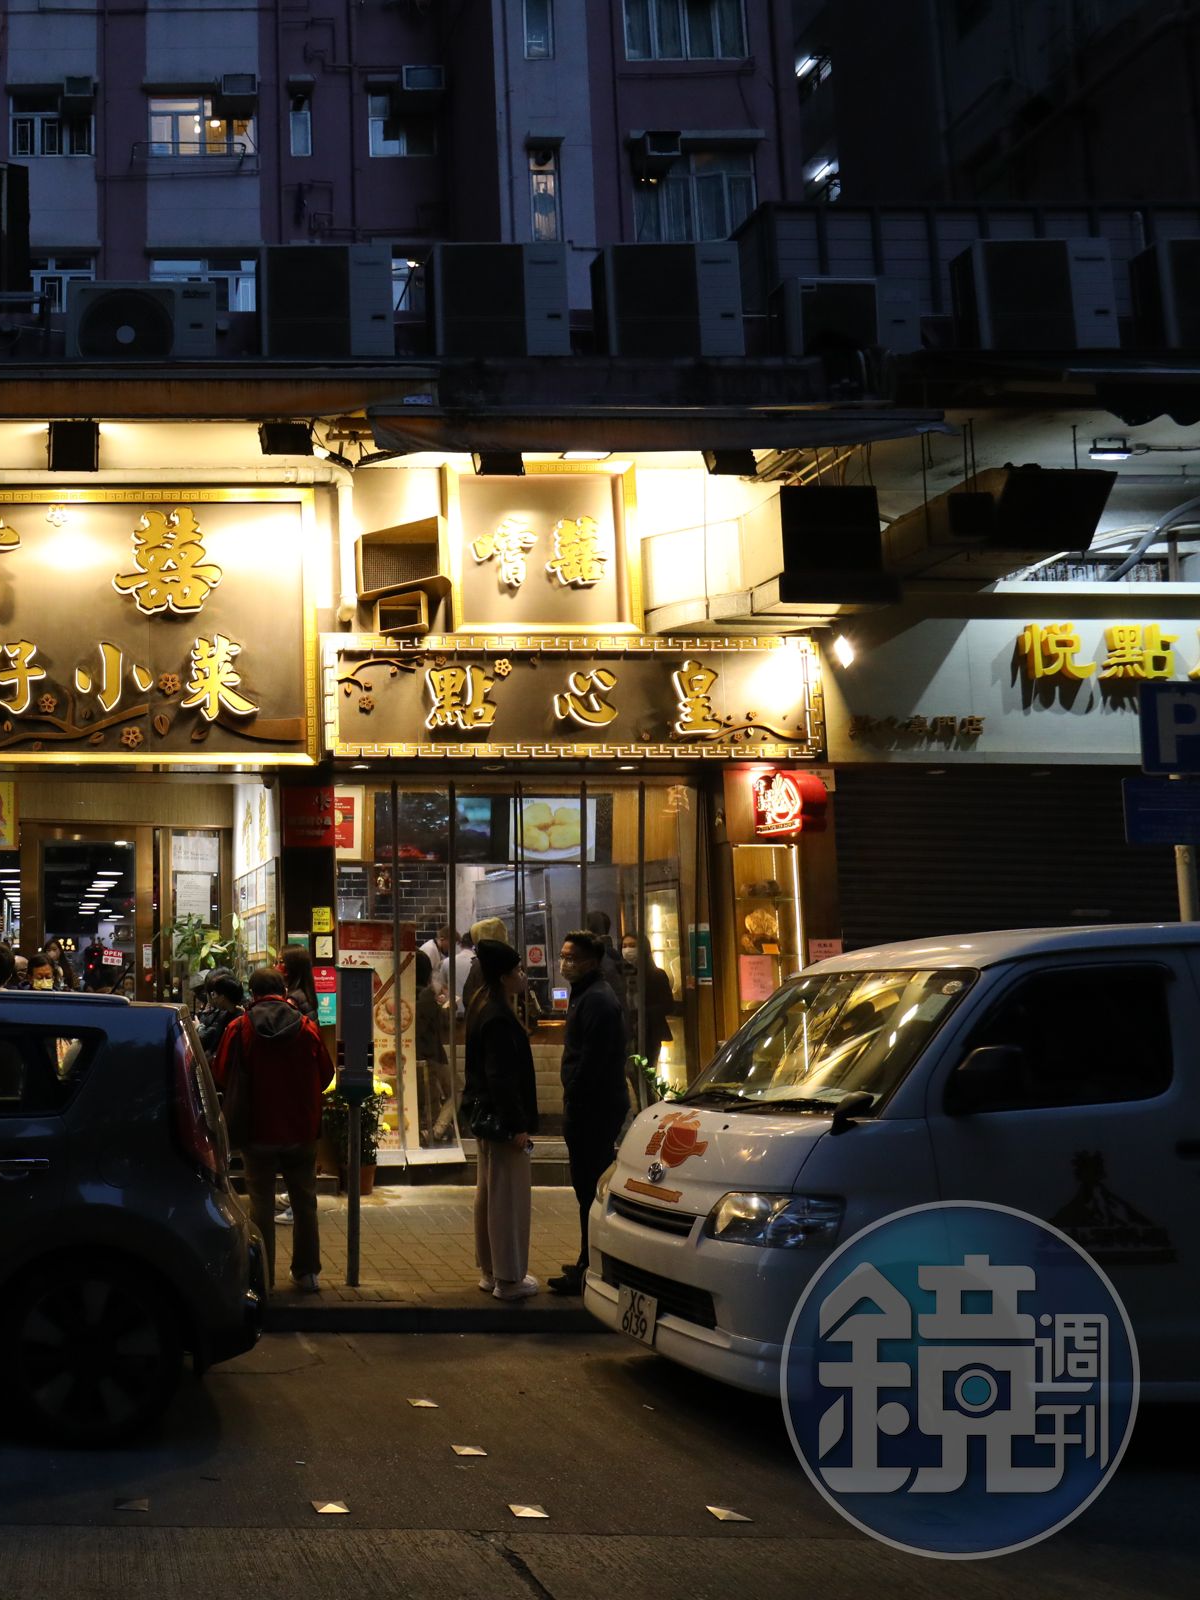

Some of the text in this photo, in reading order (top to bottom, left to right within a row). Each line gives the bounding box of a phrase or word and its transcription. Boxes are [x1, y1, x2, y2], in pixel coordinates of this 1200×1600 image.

[1017, 622, 1200, 680] 悅點
[424, 659, 721, 736] 點心皇
[1156, 691, 1200, 764] P
[622, 1310, 647, 1339] 6139
[629, 1290, 645, 1316] XC
